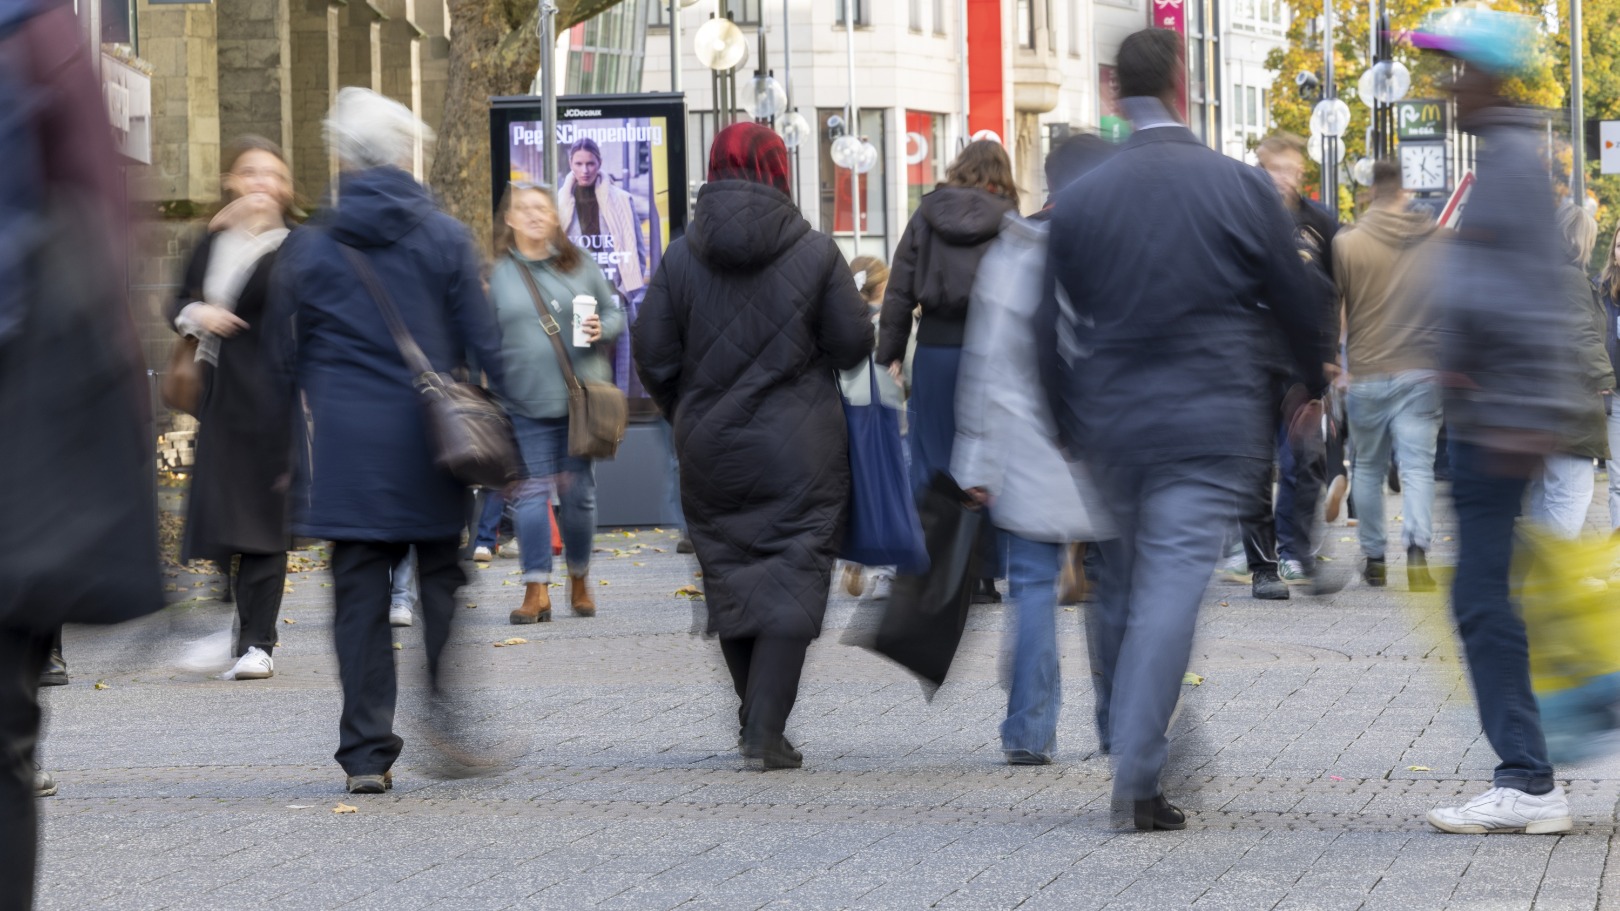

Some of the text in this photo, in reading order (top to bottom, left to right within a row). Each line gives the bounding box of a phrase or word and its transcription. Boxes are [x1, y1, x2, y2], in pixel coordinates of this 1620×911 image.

[564, 109, 602, 118] JCDecaux
[513, 123, 662, 146] Pee&Cloppenburg
[567, 234, 614, 249] YOUR
